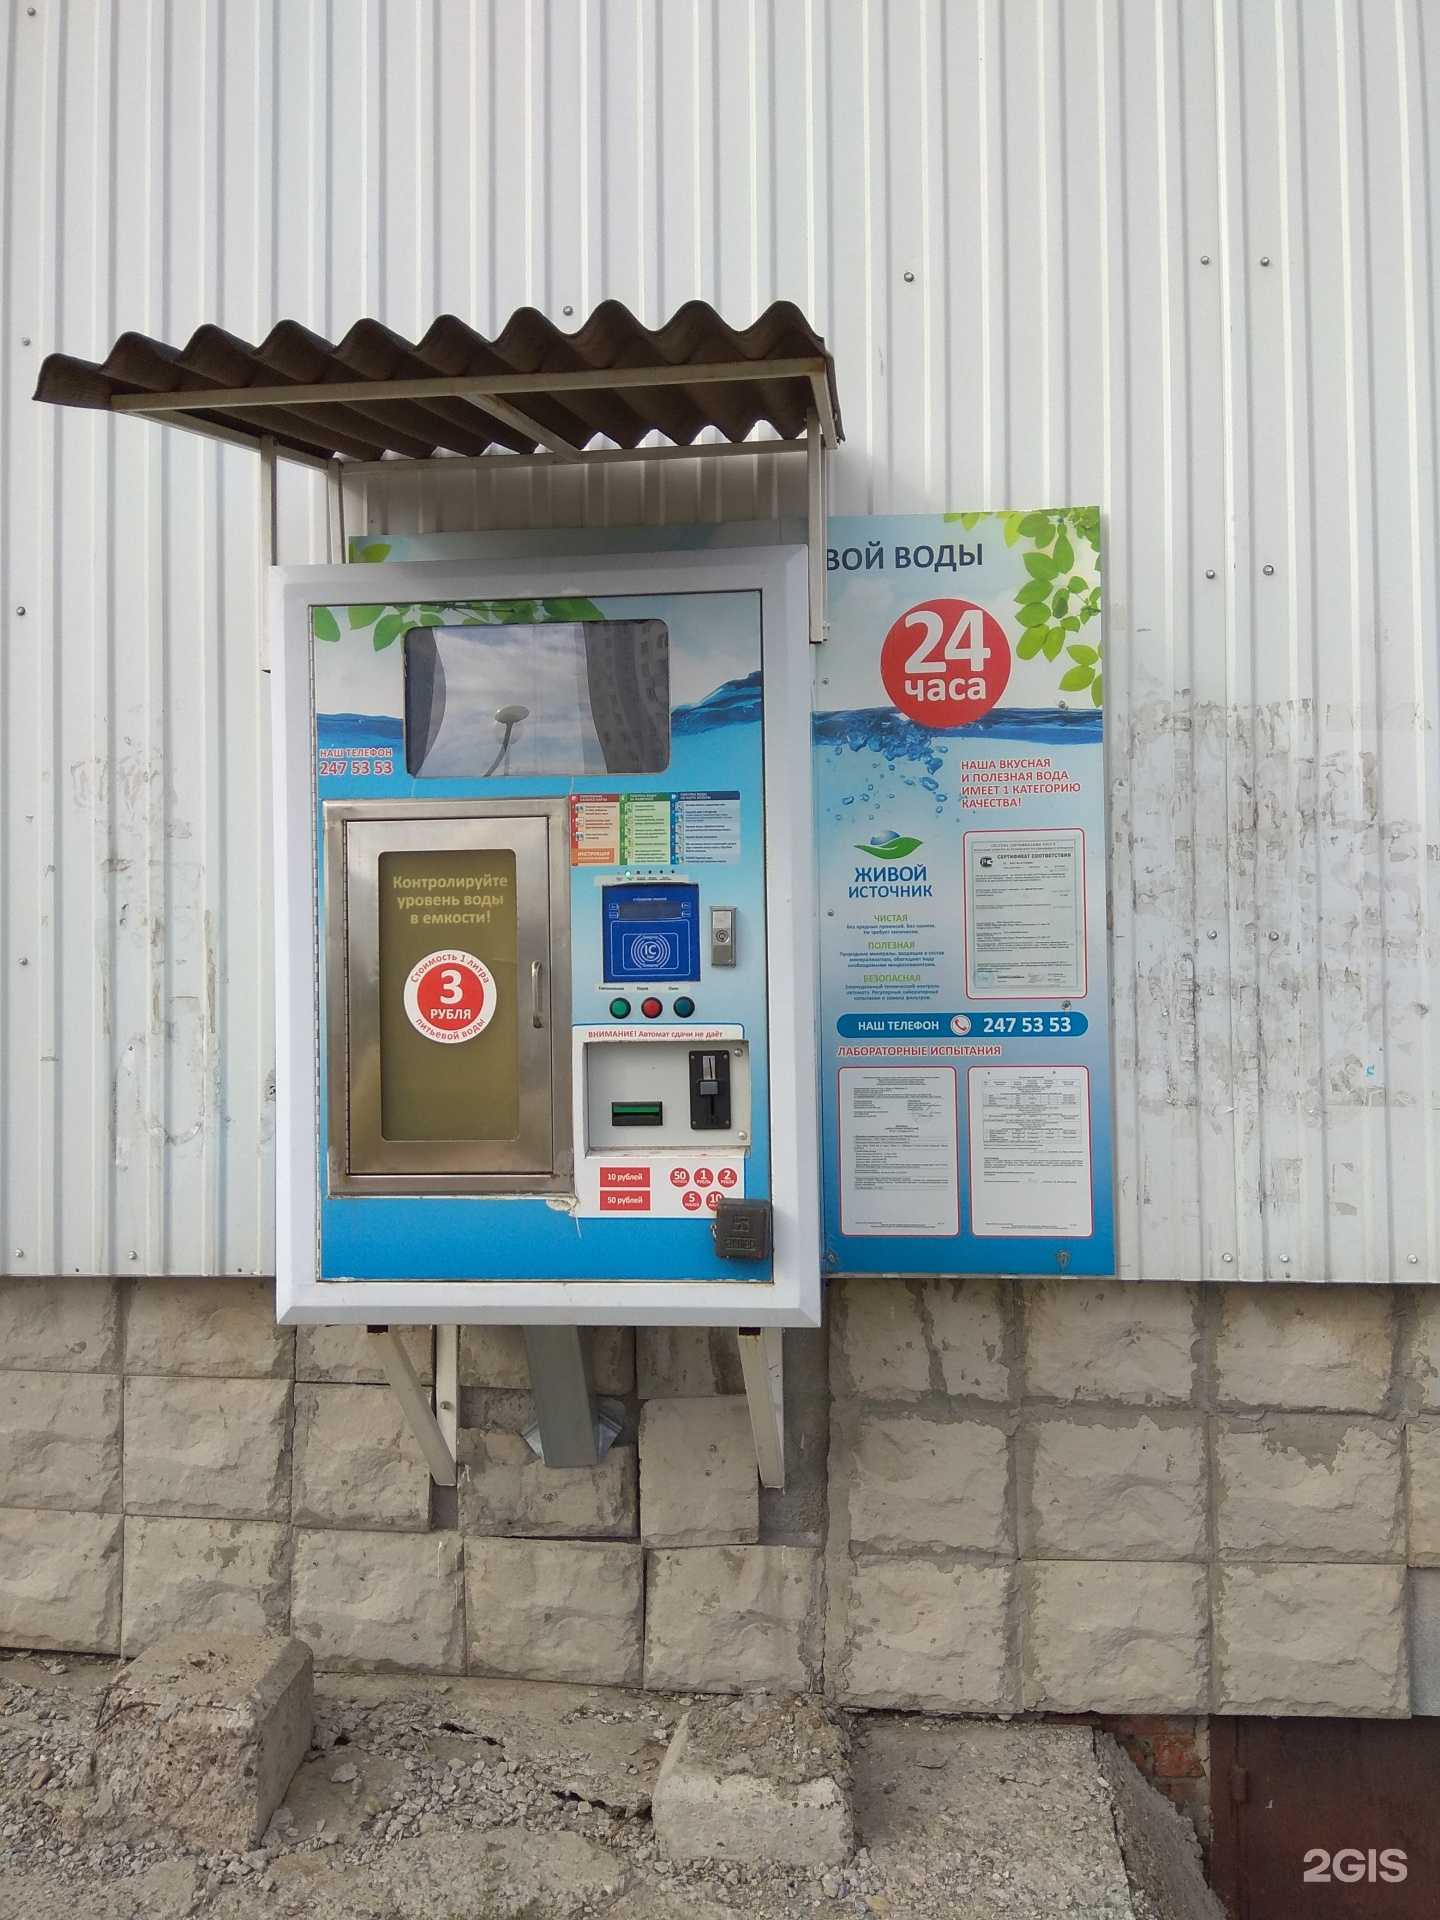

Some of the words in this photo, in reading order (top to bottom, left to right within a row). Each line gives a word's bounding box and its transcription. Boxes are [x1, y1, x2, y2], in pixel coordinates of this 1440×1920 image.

[895, 543, 983, 573] ВОДЫ
[904, 609, 992, 674] 24
[904, 677, 987, 702] часа
[320, 748, 343, 758] НАШ
[345, 748, 392, 758] ТЕЛЕФОН
[320, 761, 347, 775] 247
[351, 761, 370, 775] 53
[374, 761, 393, 775] 53
[961, 760, 996, 770] НАША
[999, 758, 1051, 769] ВКУСНАЯ
[961, 773, 969, 783] И
[973, 771, 1033, 783] ПОЛЕЗНАЯ
[1036, 770, 1069, 782] ВОДА
[962, 785, 1000, 796] ИМЕЕТ
[1003, 785, 1009, 795] 1
[1012, 782, 1081, 794] КАТЕГОРИЮ
[962, 797, 1021, 809] КАЧЕСТВА!
[855, 863, 927, 882] ЖИВОЙ
[393, 873, 509, 891] Контролируйте
[848, 884, 933, 898] ИСТОЧНИК
[396, 895, 460, 909] уровень
[463, 893, 504, 908] воды
[410, 913, 419, 924] в
[423, 910, 491, 924] емкости!
[874, 914, 908, 922] ЧИСТАЯ
[868, 941, 915, 950] ПОЛЕЗНАЯ
[410, 953, 458, 984] Стоимость
[460, 954, 466, 963] 1
[467, 958, 490, 984] литра
[863, 974, 921, 983] БЕЗОПАСНАЯ
[439, 968, 464, 1005] 3
[430, 1008, 472, 1020] РУБЛЯ
[416, 1018, 460, 1041] питьевой
[462, 1018, 487, 1038] воды
[858, 1021, 885, 1031] НАШ
[887, 1020, 940, 1031] ТЕЛЕФОН
[983, 1017, 1017, 1033] 247
[1022, 1017, 1044, 1033] 53
[1049, 1016, 1072, 1032] 53
[588, 1030, 638, 1038] ВНИМАНИЕ!
[638, 1030, 670, 1038] Автомат
[671, 1031, 693, 1039] сдачи
[706, 1030, 723, 1039] даёт
[838, 1045, 927, 1057] ЛАБОРАТОРНЫЕ
[929, 1045, 1001, 1056] ИСПЫТАНИЯ
[607, 1173, 617, 1181] 10
[617, 1173, 643, 1182] рублей
[674, 1171, 686, 1180] 50
[700, 1170, 707, 1180] 1
[724, 1170, 731, 1180] 2
[607, 1196, 617, 1204] 50
[617, 1196, 643, 1205] рублей
[688, 1193, 696, 1202] 5
